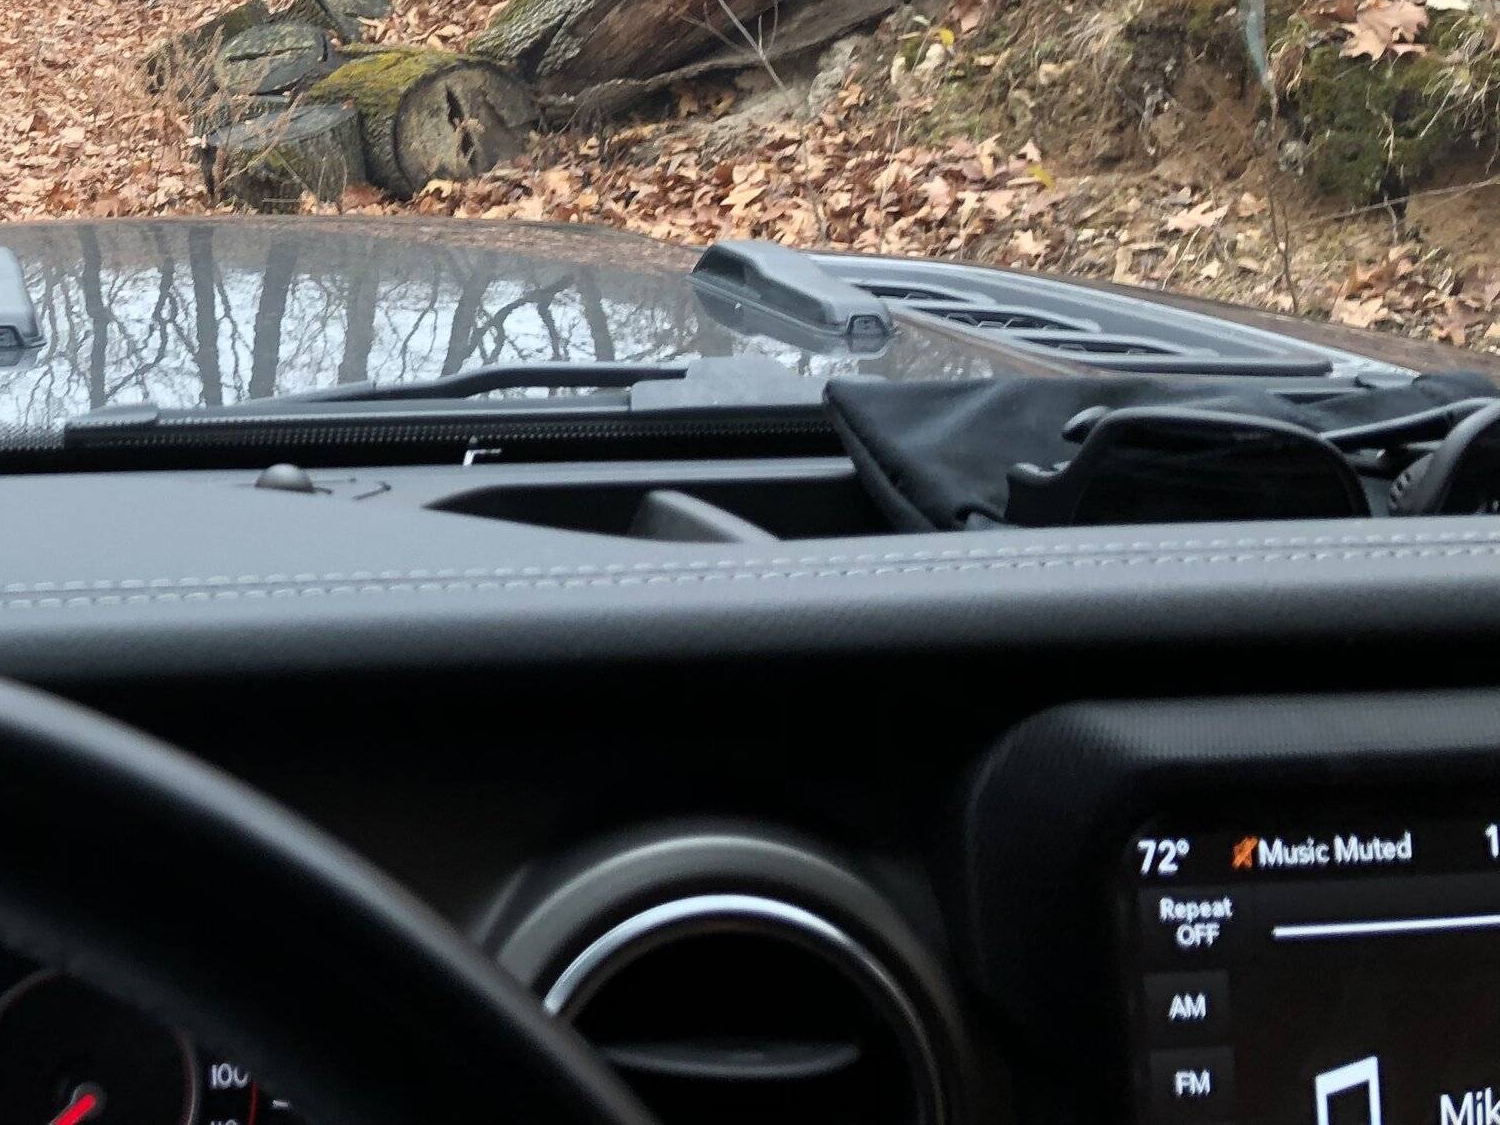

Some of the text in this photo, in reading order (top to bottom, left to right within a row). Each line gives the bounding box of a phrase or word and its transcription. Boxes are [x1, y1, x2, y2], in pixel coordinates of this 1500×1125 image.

[1258, 830, 1413, 868] Music Muted
[1159, 895, 1233, 924] Repeat
[1176, 922, 1220, 948] OFF
[1168, 992, 1207, 1021] AM
[1174, 1069, 1211, 1096] FM
